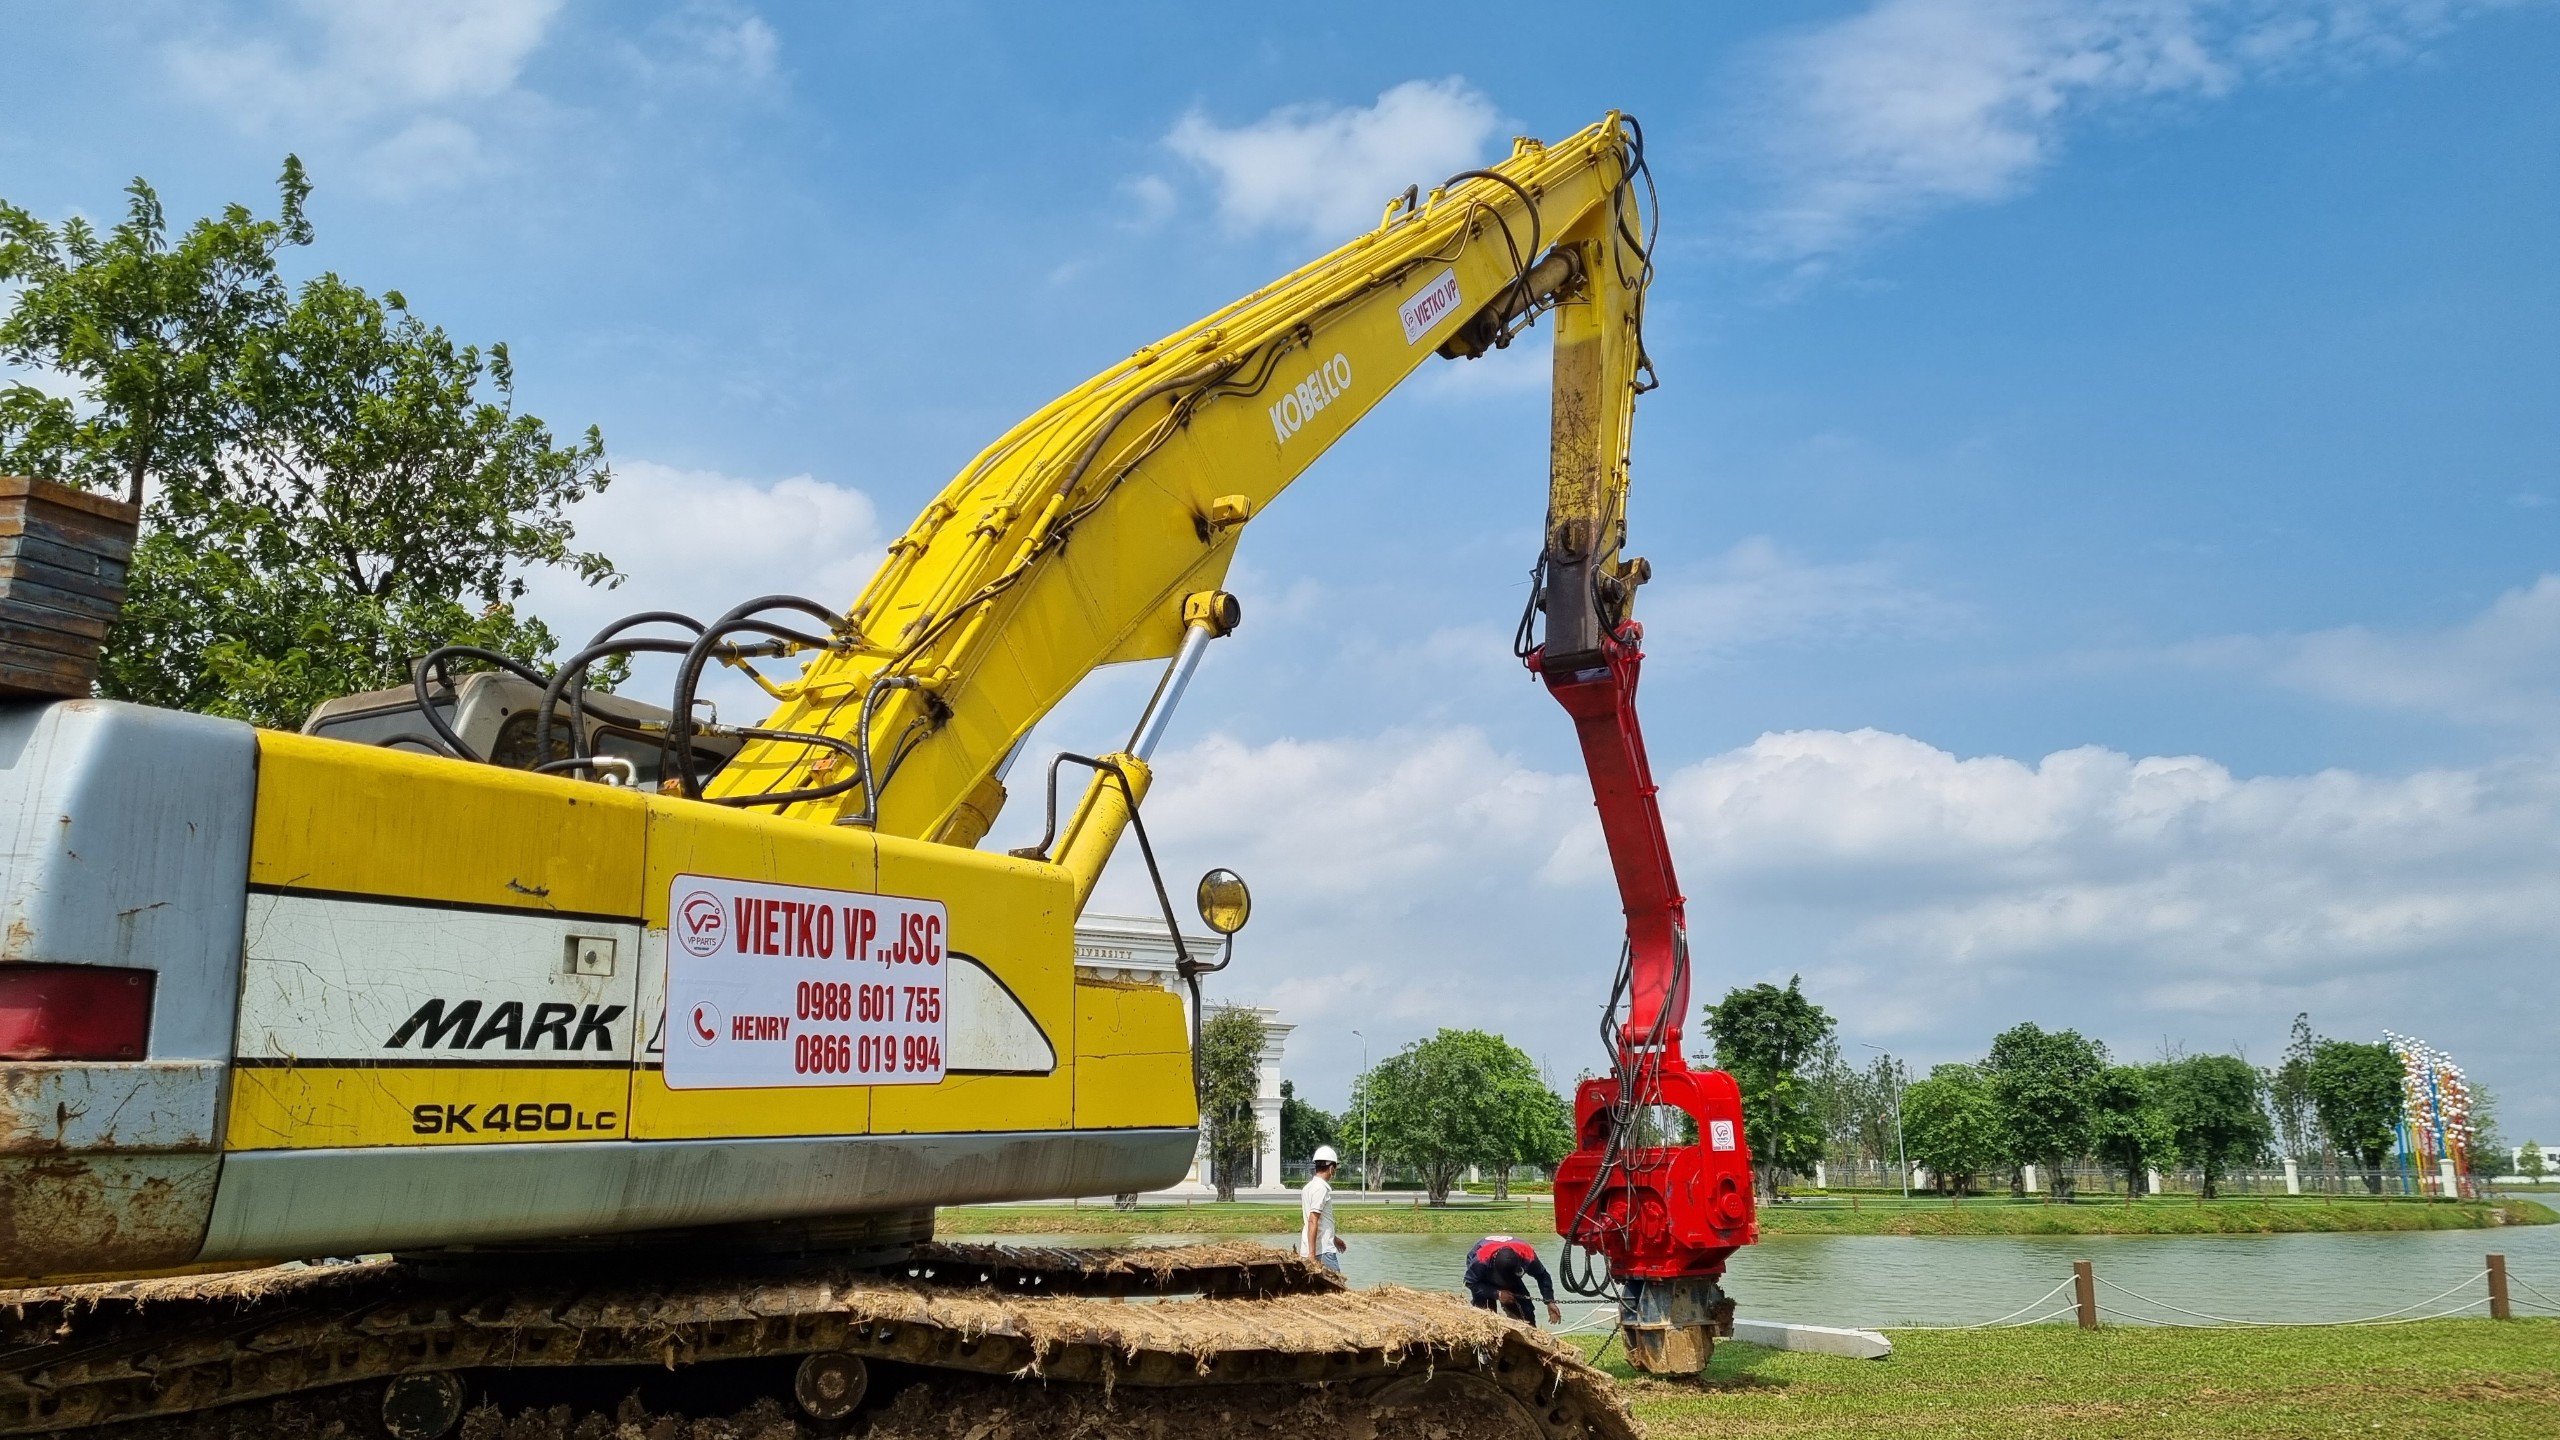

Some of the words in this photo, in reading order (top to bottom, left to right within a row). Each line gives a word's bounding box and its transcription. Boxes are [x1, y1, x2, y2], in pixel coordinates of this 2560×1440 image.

[1413, 288, 1446, 327] VIETKO
[1443, 278, 1457, 302] VP
[1268, 352, 1353, 445] KOBELCO
[687, 936, 696, 945] VP
[696, 937, 717, 946] PARTS
[734, 897, 834, 959] VIETKO
[1073, 947, 1132, 960] NIVERSITY
[796, 981, 852, 1022] 0988
[859, 984, 895, 1023] 601
[904, 986, 941, 1024] 755
[383, 998, 628, 1051] MARK
[731, 1015, 790, 1041] HENRY
[795, 1034, 852, 1075] 0866
[858, 1035, 898, 1074] 019
[904, 1035, 941, 1073] 994
